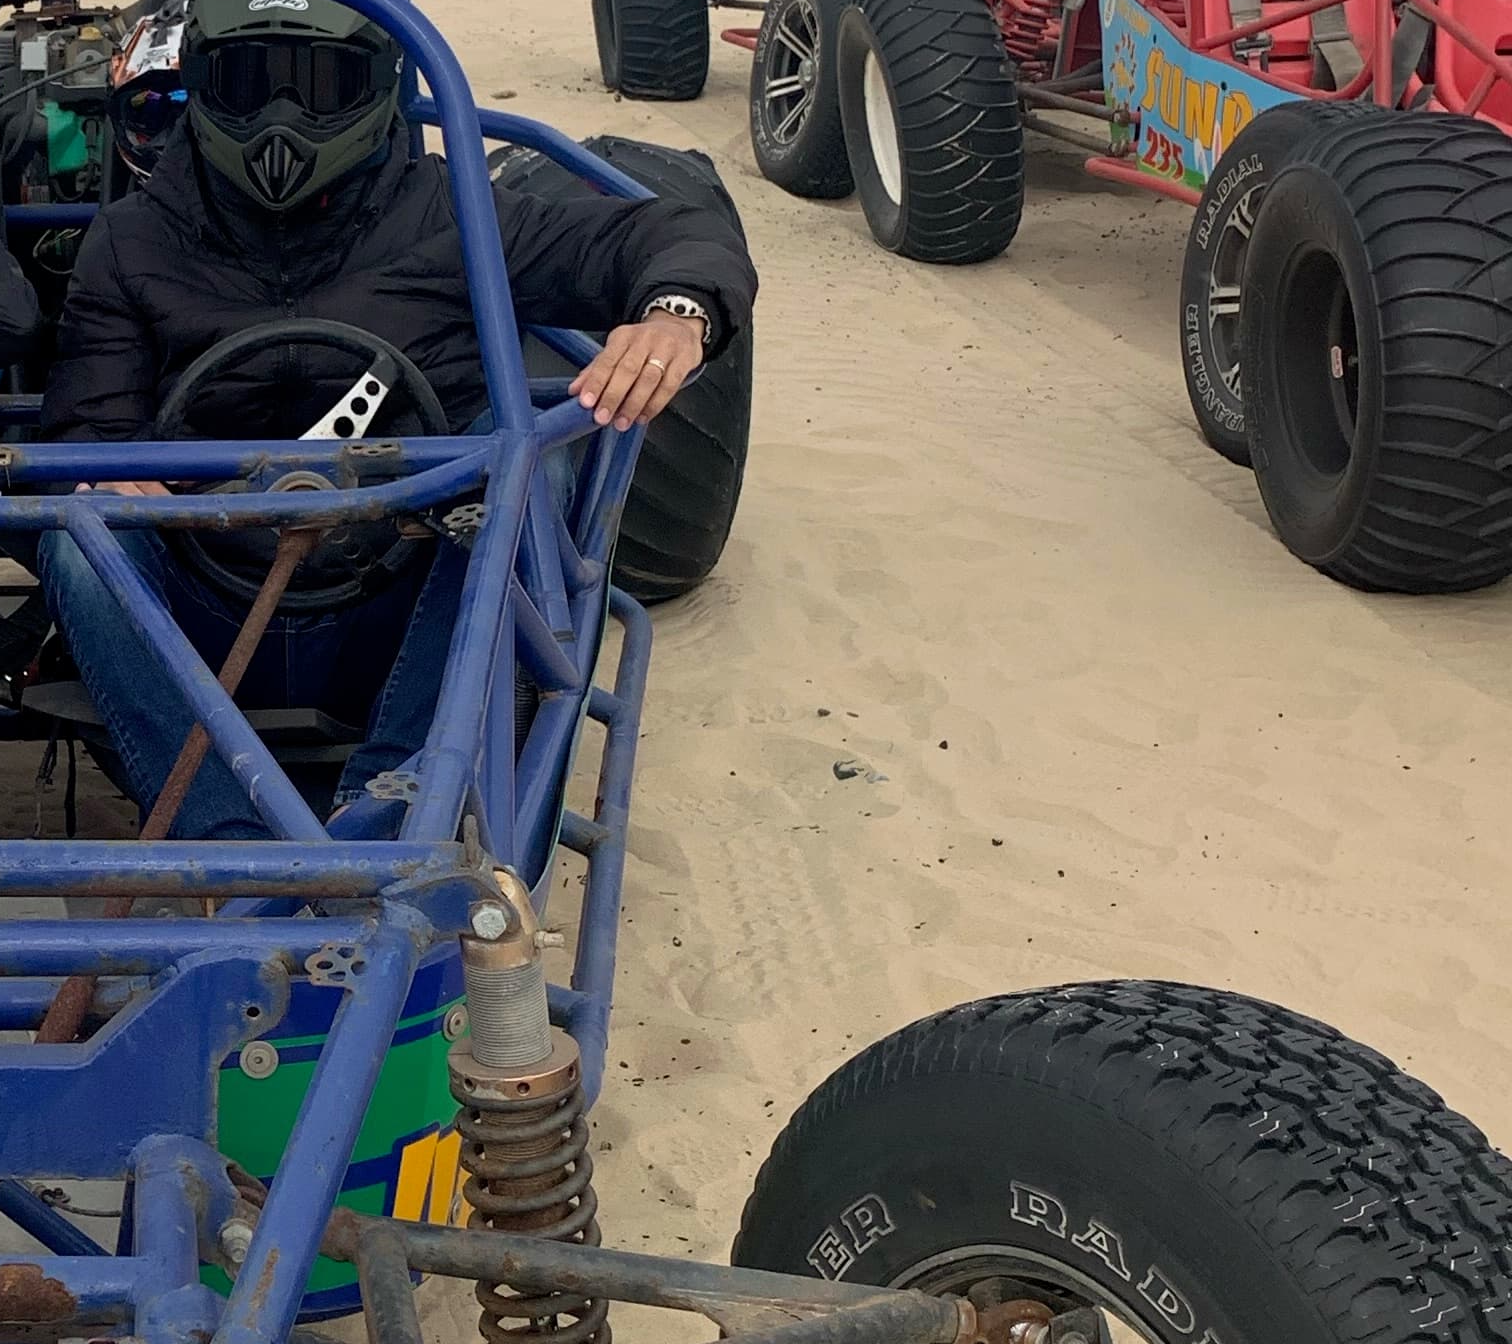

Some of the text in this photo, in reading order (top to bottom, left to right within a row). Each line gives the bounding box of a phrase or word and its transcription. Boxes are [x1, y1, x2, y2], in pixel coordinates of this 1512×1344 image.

[1141, 126, 1185, 180] 235
[1196, 153, 1264, 250] RADIAL
[1186, 304, 1245, 433] RANGLER
